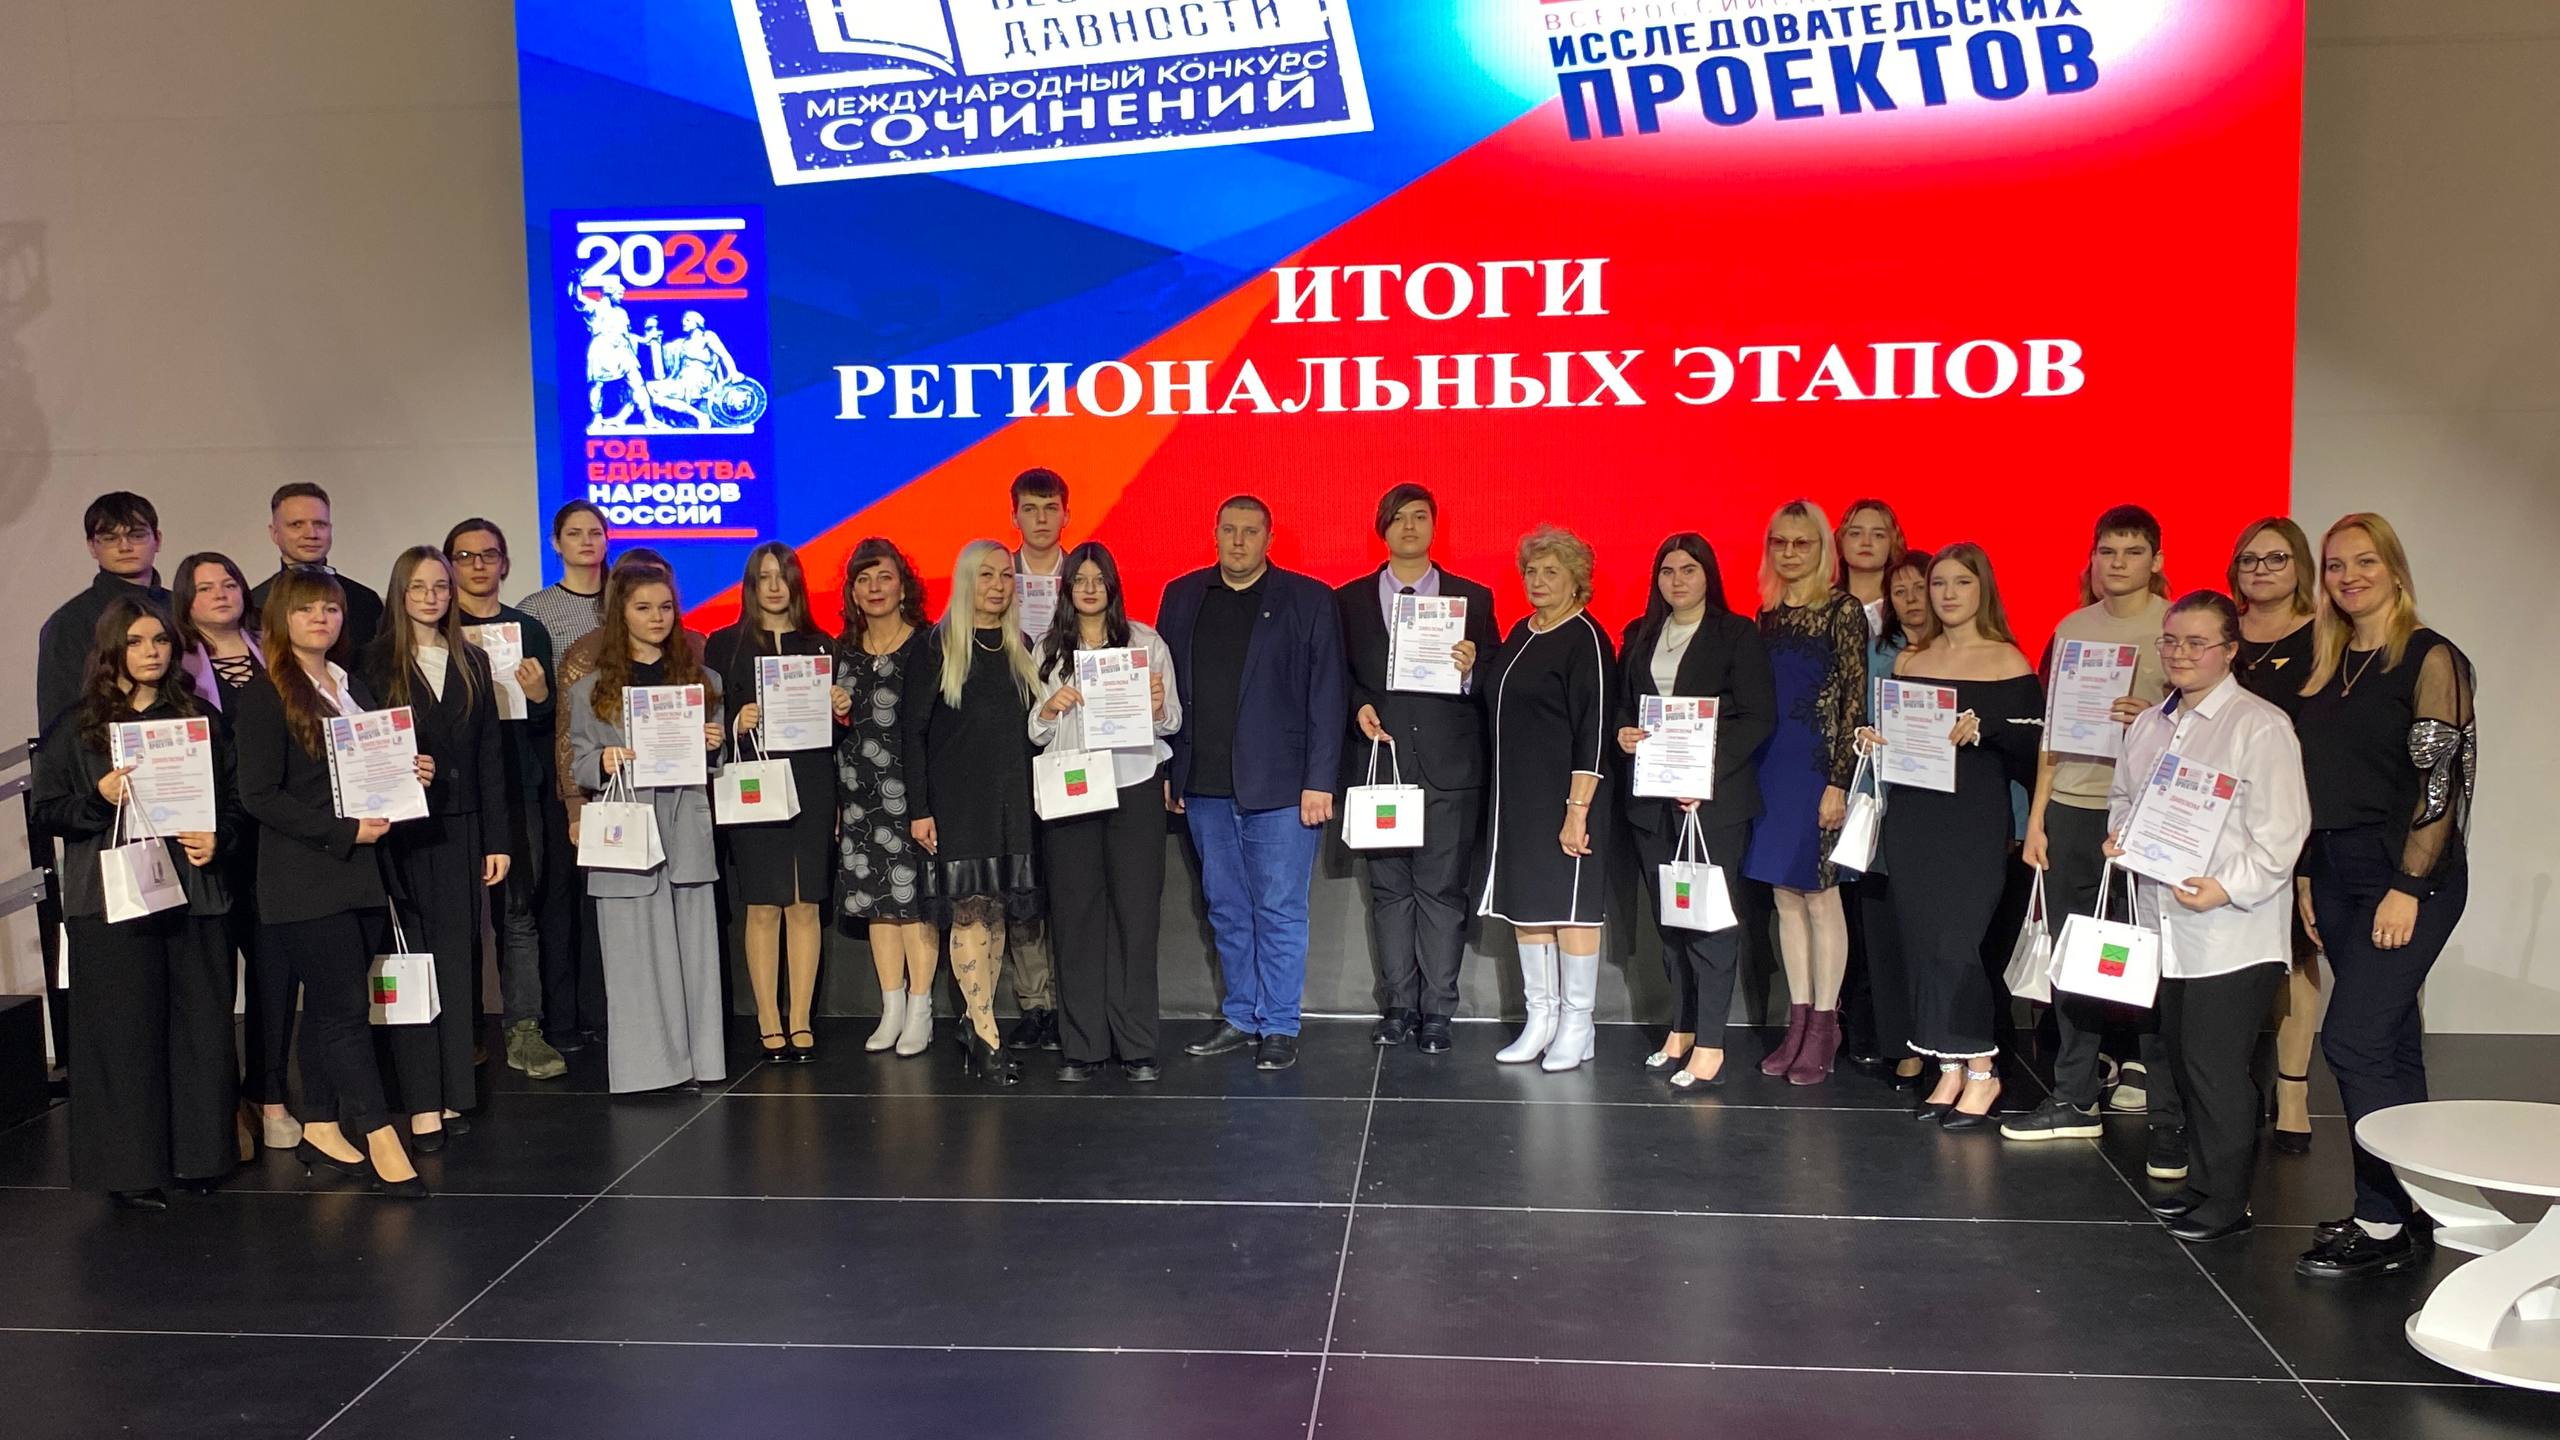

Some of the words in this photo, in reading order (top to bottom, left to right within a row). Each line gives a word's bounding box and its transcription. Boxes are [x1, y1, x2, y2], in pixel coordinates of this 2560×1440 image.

[1004, 0, 1281, 59] ДАВНОСТИ
[805, 65, 1145, 119] МЕЖДУНАРОДНЫЙ
[1157, 50, 1328, 85] КОНКУРС
[819, 69, 1315, 152] СОЧИНЕНИЙ
[1557, 23, 2099, 141] ПРОЕКТОВ
[577, 234, 748, 287] 2026
[1270, 258, 1610, 324] ИТОГИ
[833, 349, 1646, 420] РЕГИОНАЛЬНЫХ
[1674, 339, 2085, 405] ЭТАПОВ
[586, 439, 650, 461] ГОД
[588, 460, 756, 484] ЕДИНСТВА
[589, 482, 741, 505] НАРОДОВ
